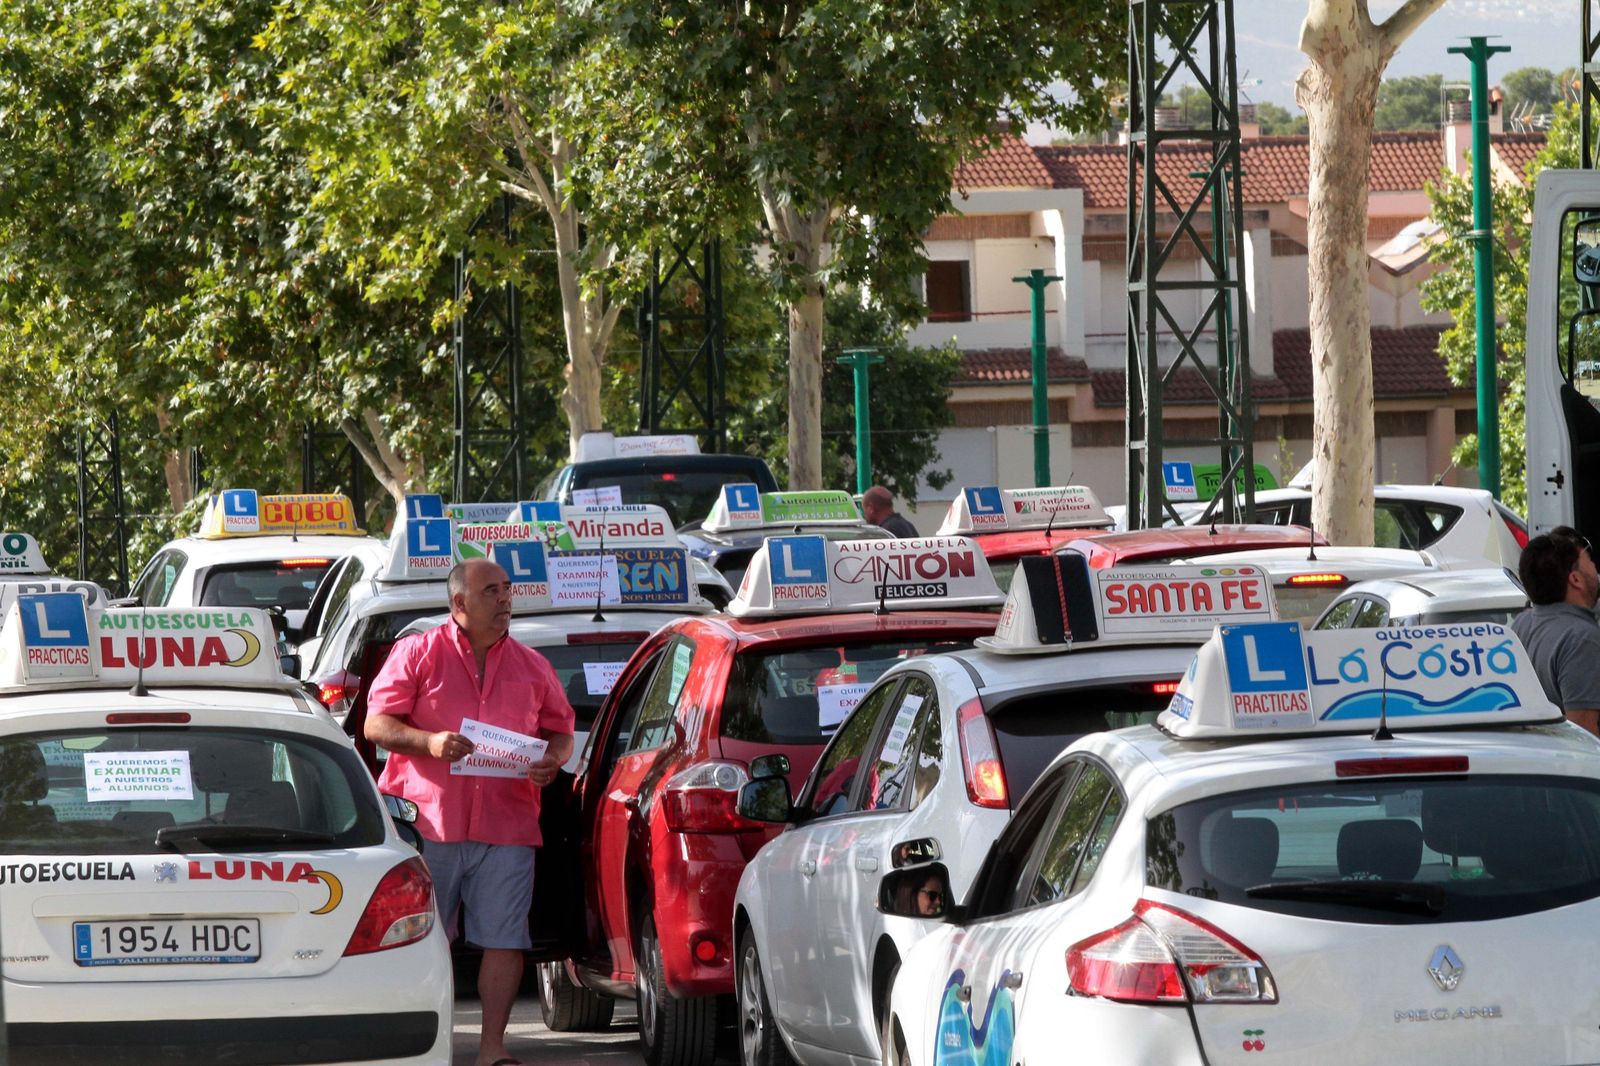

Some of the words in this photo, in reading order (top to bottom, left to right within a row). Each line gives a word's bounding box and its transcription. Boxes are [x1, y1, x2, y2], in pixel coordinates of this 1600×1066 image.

[1172, 466, 1184, 483] L
[735, 490, 750, 508] L
[1167, 486, 1194, 494] PRACTICAS
[234, 494, 247, 512] L
[414, 499, 432, 518] L
[773, 495, 848, 507] Autoescuela
[973, 491, 994, 511] L
[227, 516, 257, 525] PRACTICAS
[264, 501, 344, 523] COBO
[730, 513, 760, 521] PRACTICAS
[972, 514, 1006, 523] PRACTICAS
[461, 524, 531, 542] AUTOESCUELA
[567, 518, 664, 538] Miranda
[419, 525, 440, 552] L
[839, 537, 967, 553] AUTOESCUELA
[409, 556, 451, 569] PRACTICAS
[511, 549, 531, 576] L
[782, 544, 812, 577] L
[833, 550, 976, 584] CANTÓN
[557, 570, 609, 580] EXAMINAR
[508, 583, 547, 596] RACTICAS
[557, 590, 607, 600] ALUMNOS
[774, 584, 827, 600] PRACTICAS
[877, 583, 945, 599] PELIGROS
[1106, 581, 1213, 614] SANTA
[1220, 579, 1263, 610] FE
[35, 602, 71, 638] L
[99, 611, 255, 630] AUTOESCUELA
[1375, 624, 1505, 642] autoescuela
[28, 647, 90, 666] PRACTICAS
[100, 636, 232, 668] LUNA
[1243, 634, 1287, 682] L
[1233, 692, 1308, 714] PRACTICAS
[481, 729, 528, 748] QUEREMOS
[466, 757, 518, 769] ALUMNOS
[475, 743, 532, 765] EXAMINAR
[94, 767, 182, 776] EXAMINAR
[108, 784, 170, 792] ALUMNOS
[188, 860, 321, 884] LUNA
[102, 926, 179, 954] 1954
[192, 925, 252, 952] HDC
[81, 945, 88, 953] E
[1394, 1006, 1503, 1022] MEGANE
